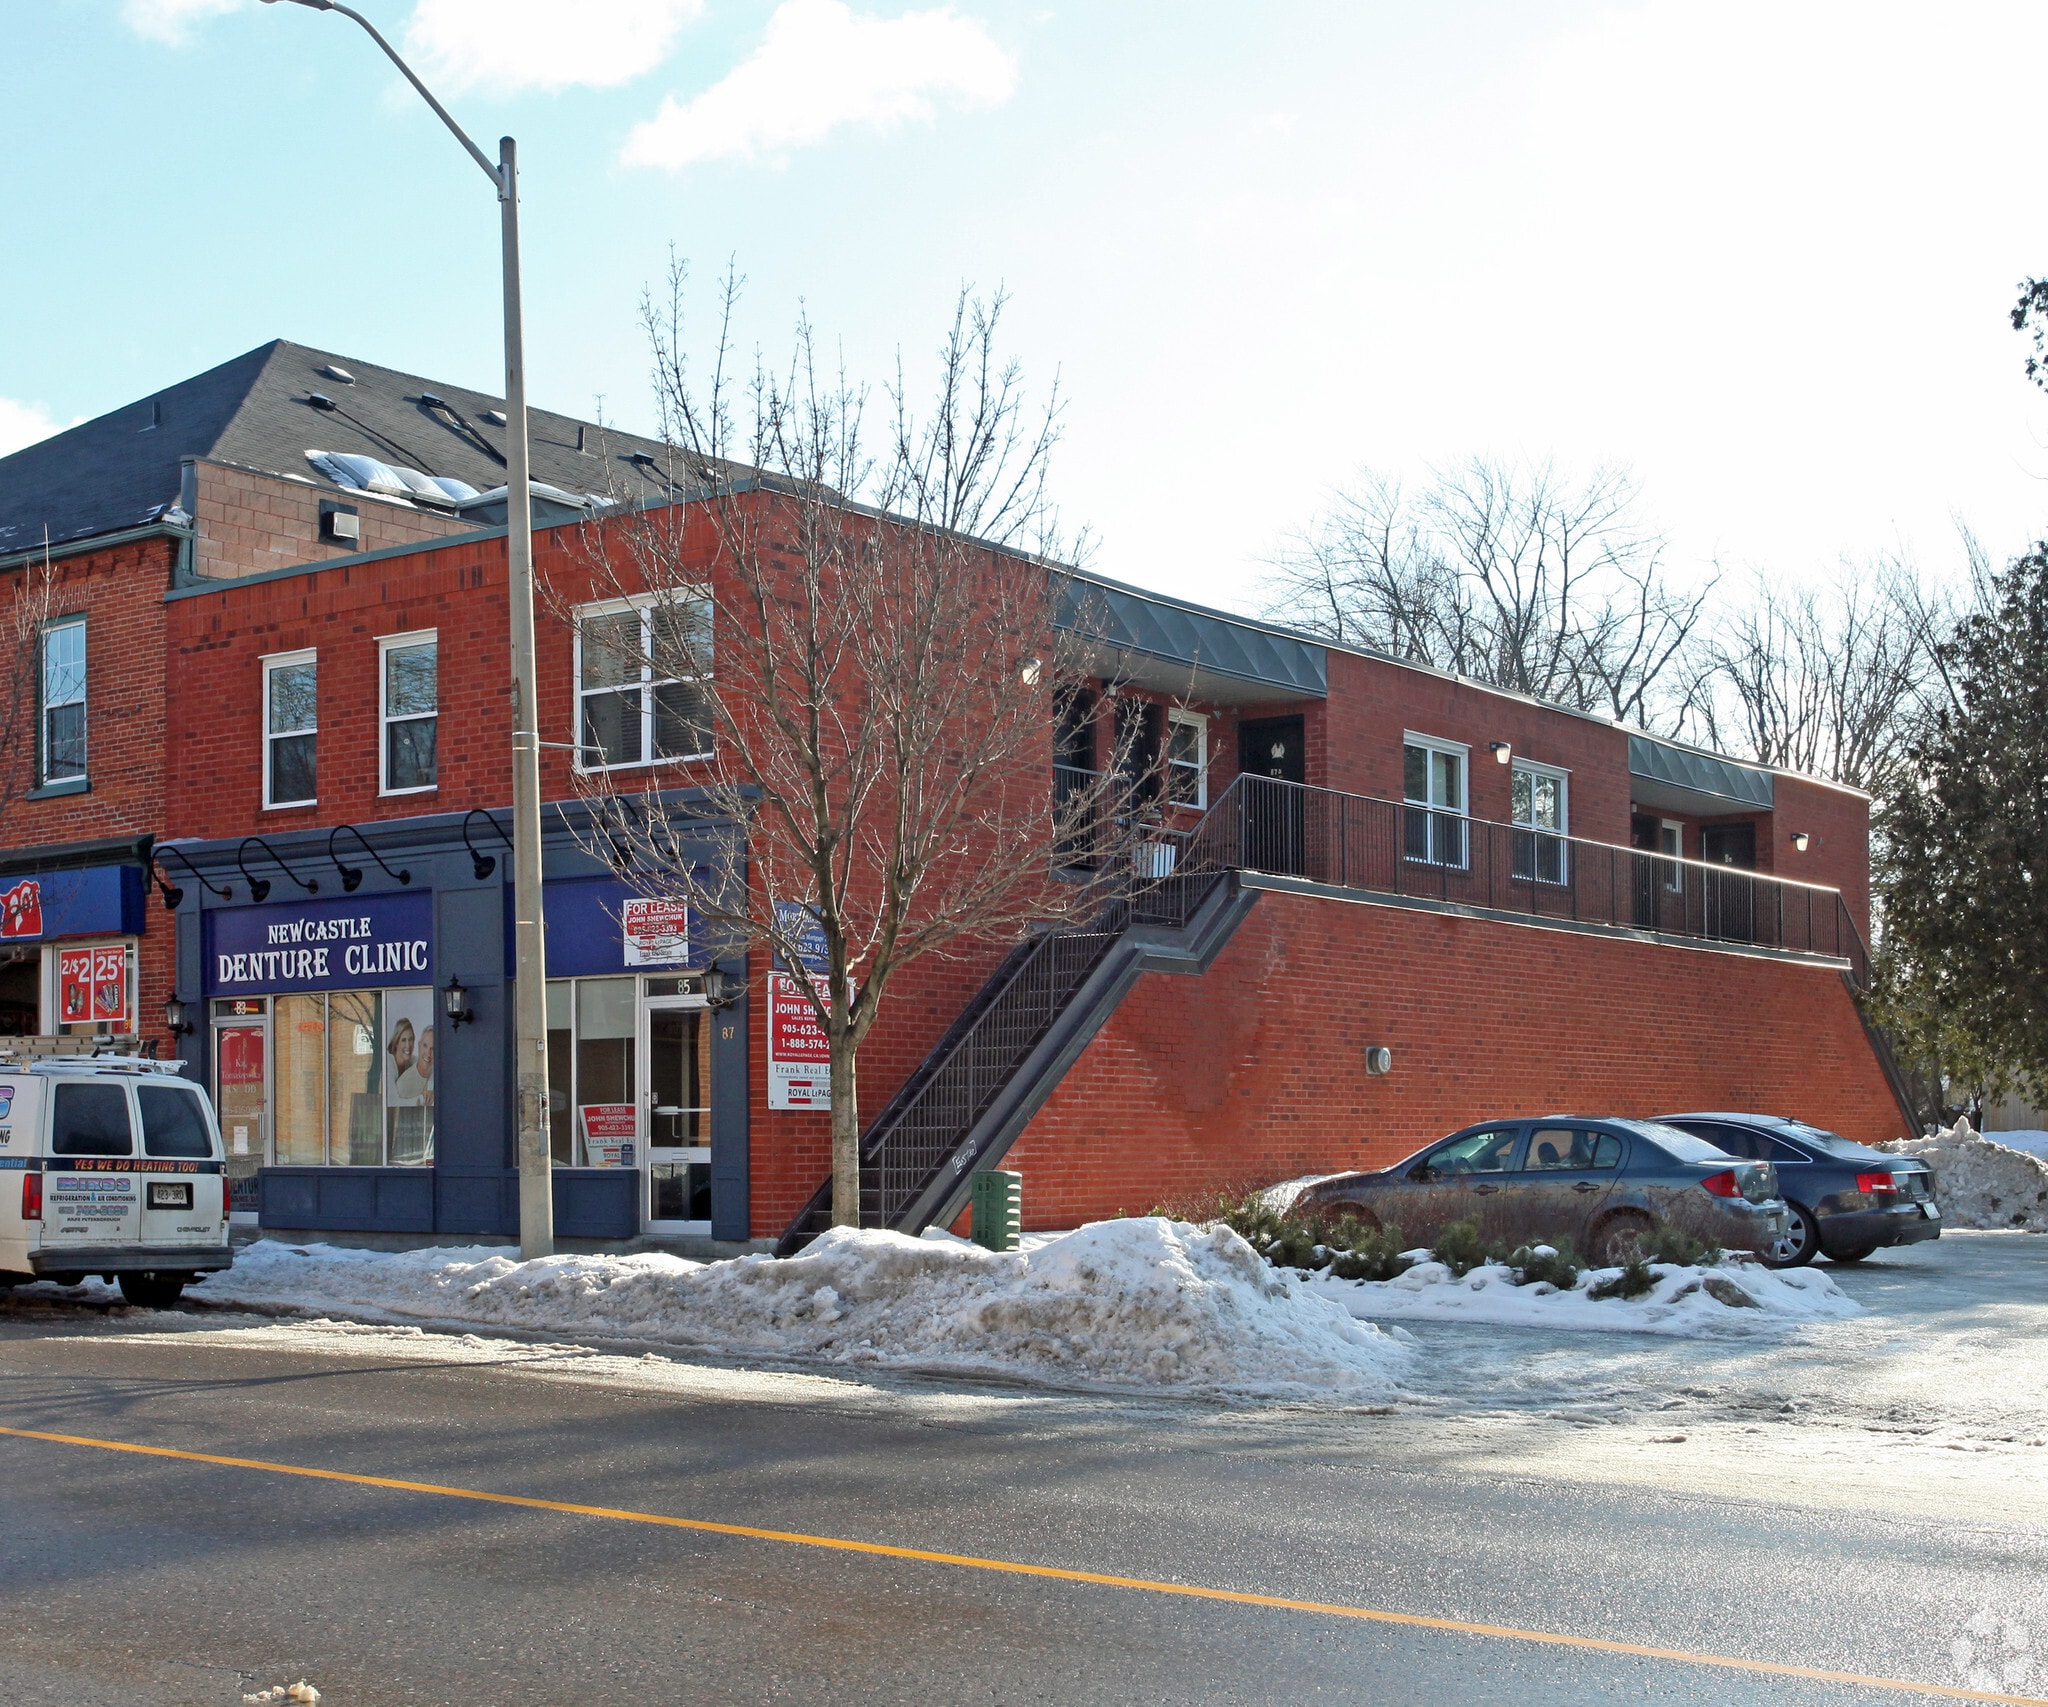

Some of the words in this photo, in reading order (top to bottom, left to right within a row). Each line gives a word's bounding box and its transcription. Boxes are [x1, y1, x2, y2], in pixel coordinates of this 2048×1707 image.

[627, 903, 648, 915] FOR
[650, 901, 684, 913] LEASE
[268, 917, 371, 944] NEWCASTLE
[218, 948, 331, 983] DENTURE
[344, 940, 428, 975] CLINIC
[677, 979, 690, 995] 85
[775, 1003, 800, 1014] JOHN
[722, 1027, 735, 1040] 87
[775, 1064, 800, 1075] Frank
[804, 1065, 821, 1074] Real
[788, 1089, 810, 1097] ROYAL
[74, 1159, 94, 1170] YES
[97, 1160, 113, 1171] WE
[115, 1160, 130, 1171] DO
[133, 1161, 175, 1172] HEATING
[178, 1162, 200, 1173] TOO!
[91, 1192, 97, 1202] &
